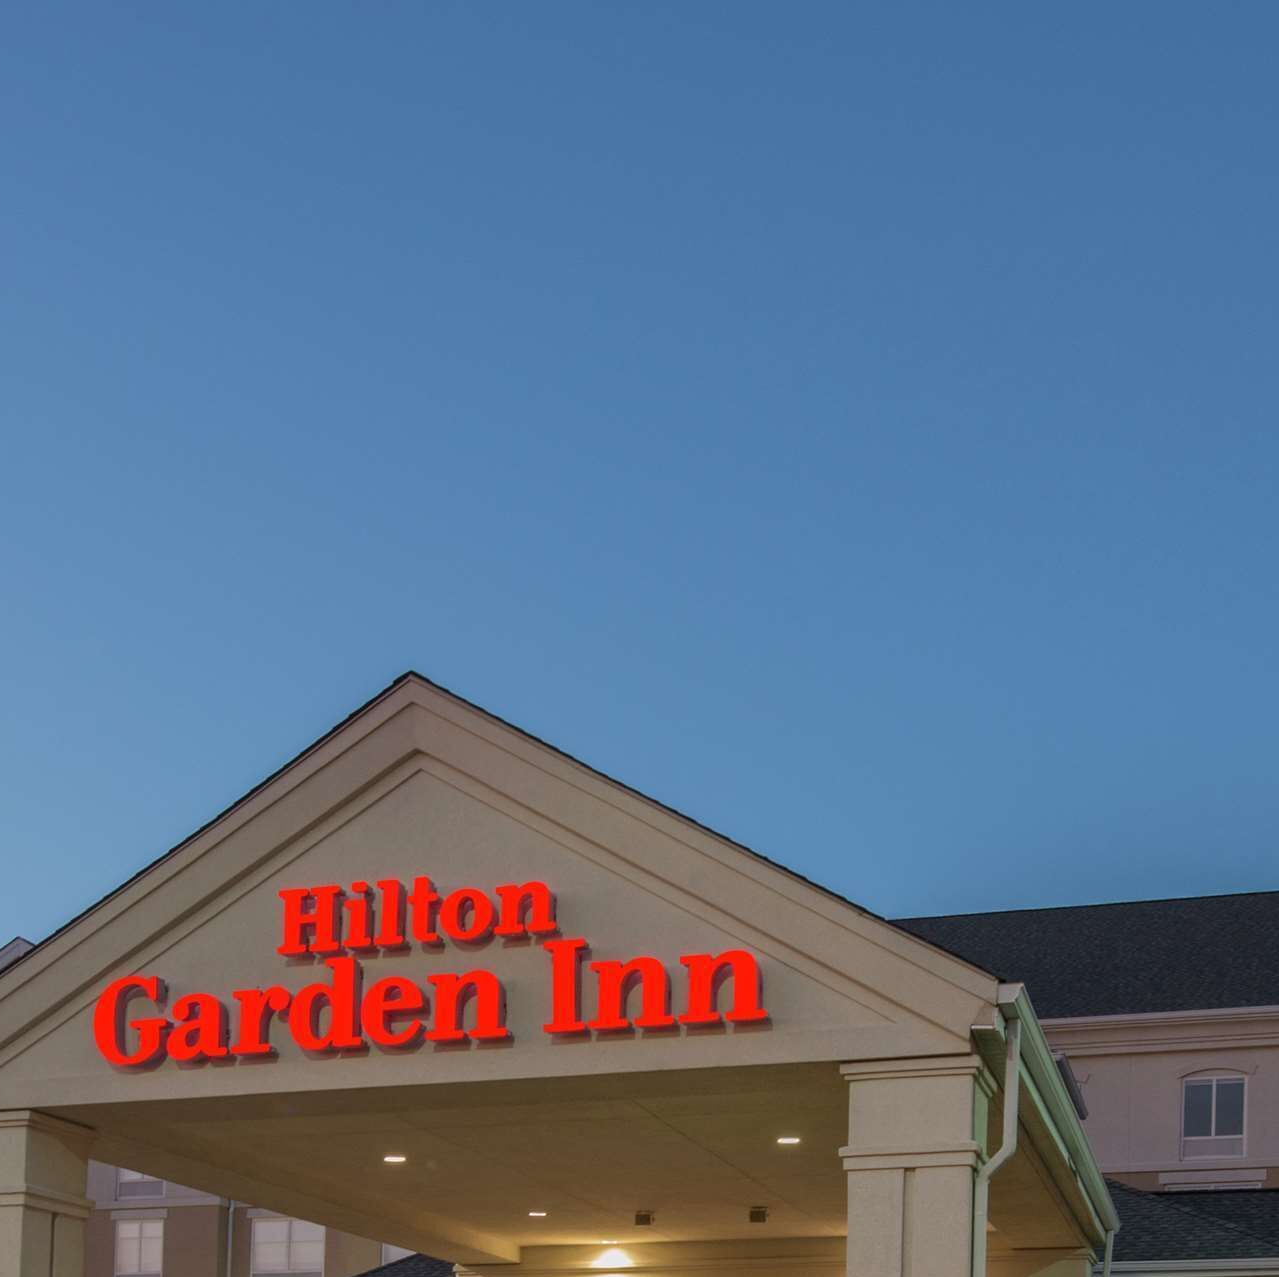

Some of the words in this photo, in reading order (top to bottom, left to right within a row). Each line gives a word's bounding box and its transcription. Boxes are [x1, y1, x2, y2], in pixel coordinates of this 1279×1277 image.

[276, 875, 557, 956] Hilton
[93, 957, 508, 1066] Garden
[543, 938, 768, 1034] Inn
